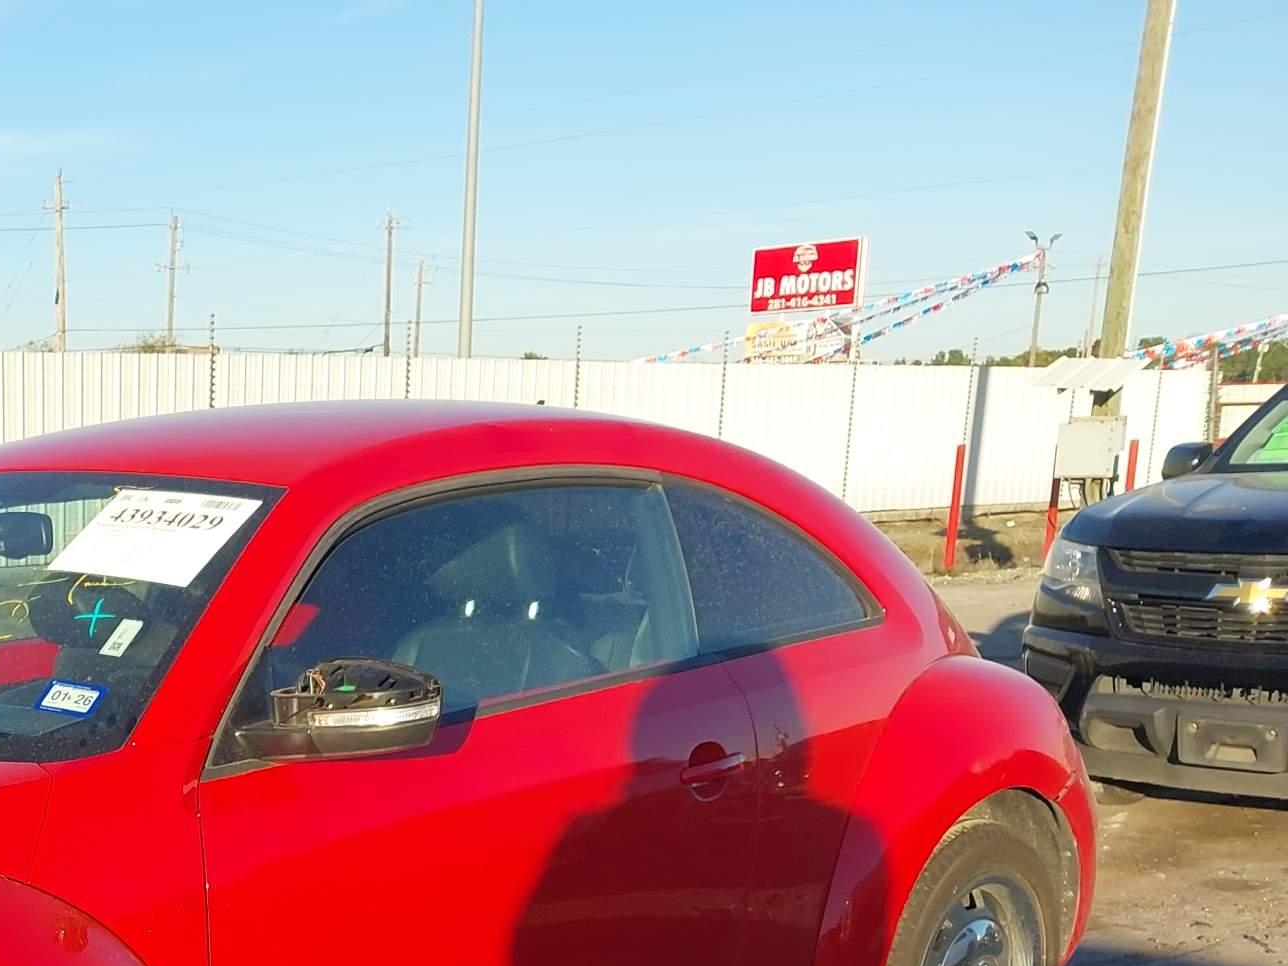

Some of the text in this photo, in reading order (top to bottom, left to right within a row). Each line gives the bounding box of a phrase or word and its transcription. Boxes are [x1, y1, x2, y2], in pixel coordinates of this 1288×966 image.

[754, 269, 854, 299] JB MOTORS
[109, 507, 224, 530] 43934029
[50, 690, 94, 706] 01 26
